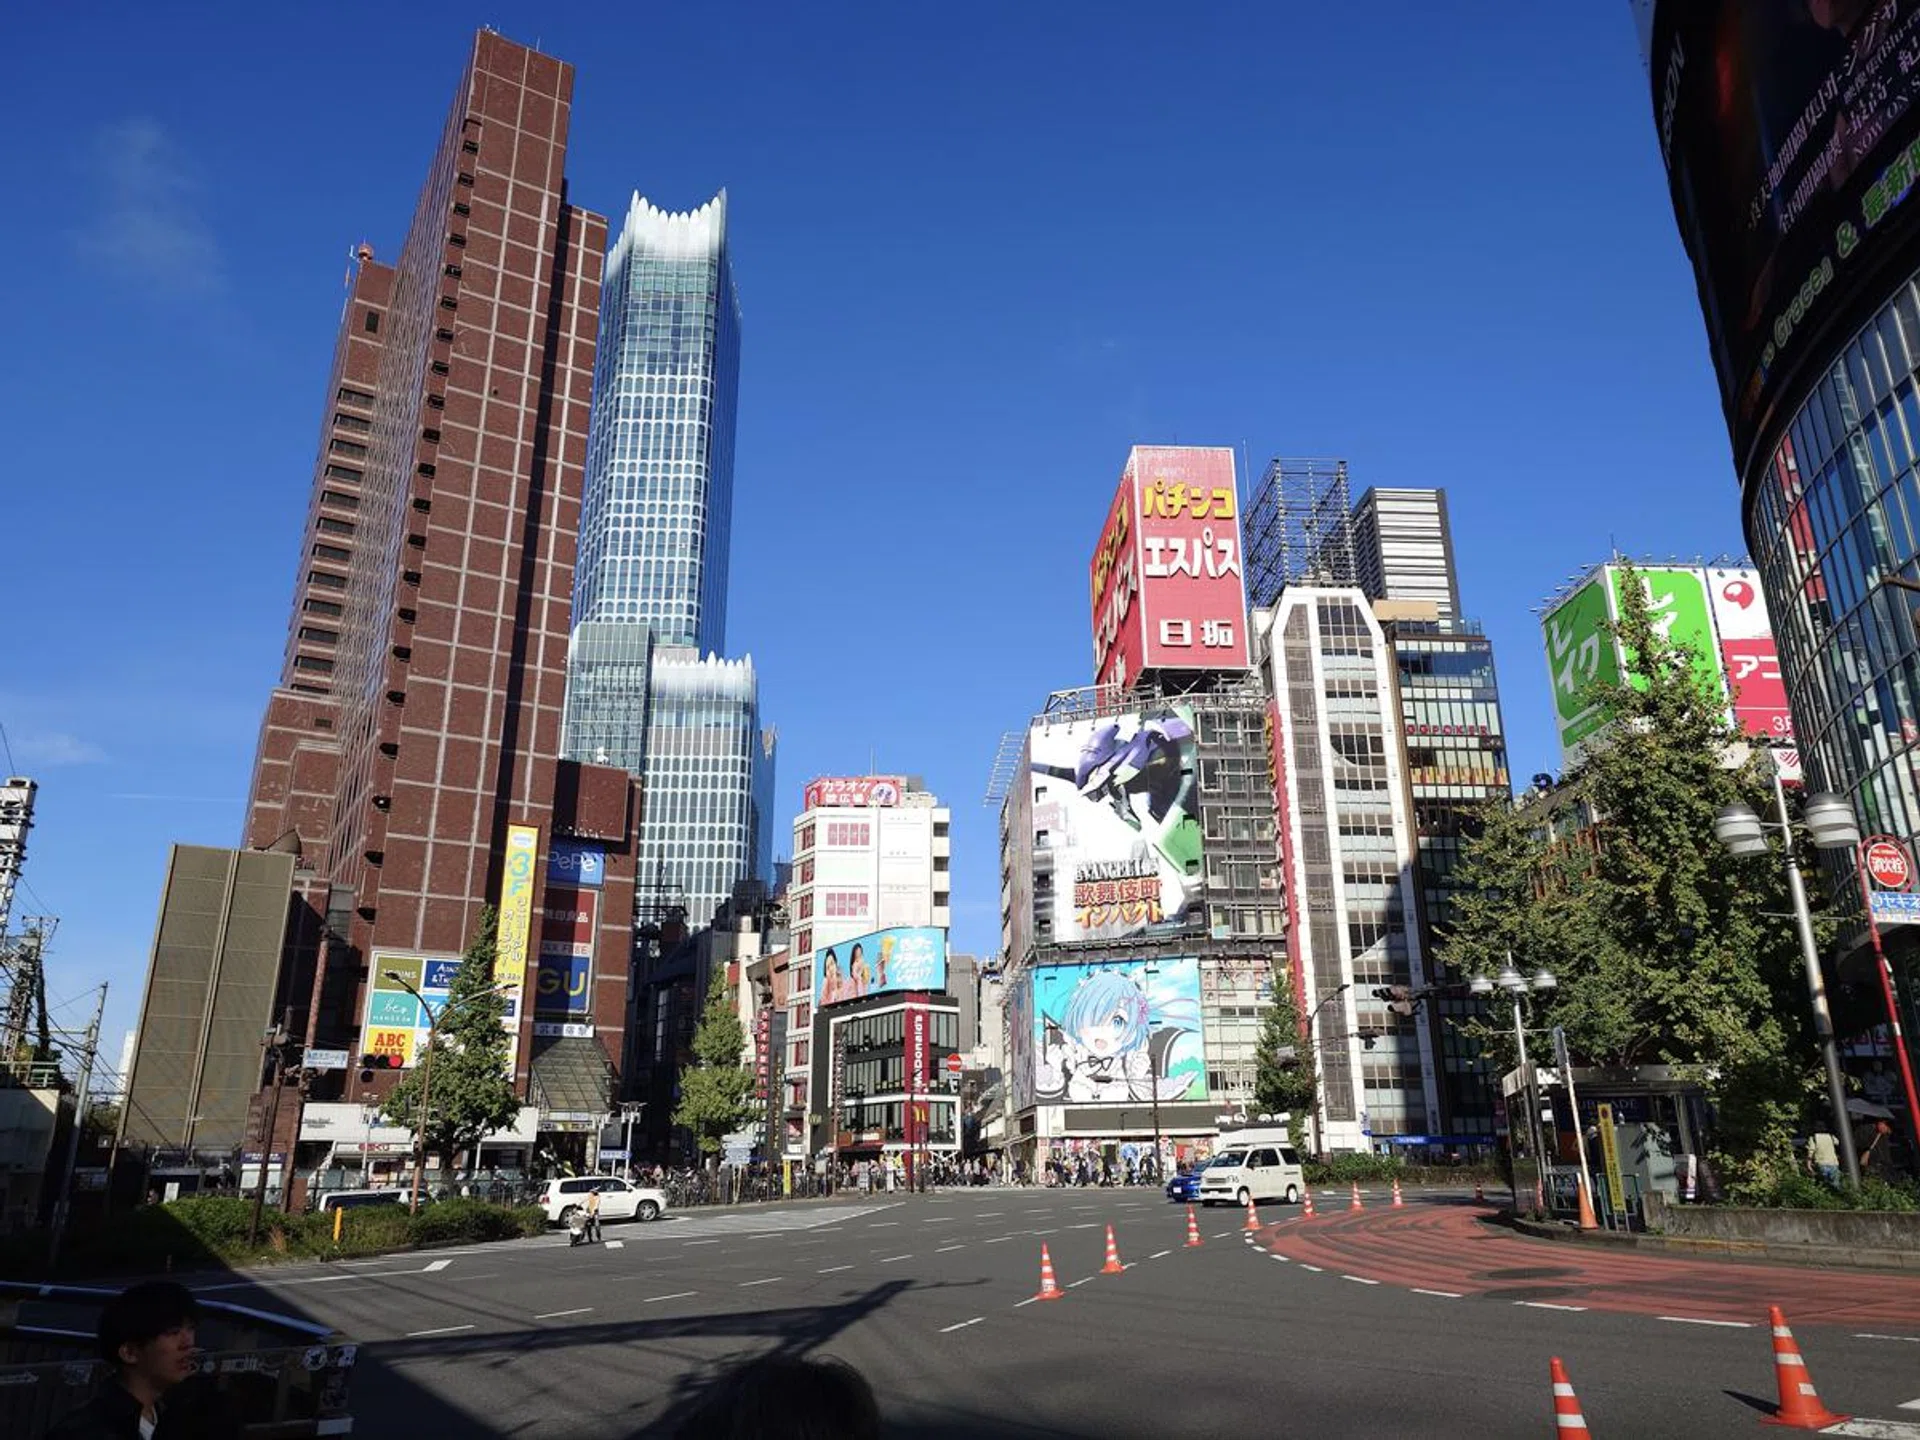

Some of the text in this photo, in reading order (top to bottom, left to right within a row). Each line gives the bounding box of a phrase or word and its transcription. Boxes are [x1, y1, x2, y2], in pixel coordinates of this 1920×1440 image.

[1143, 477, 1235, 519] パチンコ
[1144, 527, 1240, 579] エスパス
[1160, 618, 1234, 648] 日拓
[822, 780, 870, 792] カラオケ
[548, 849, 596, 872] PePe
[1075, 857, 1160, 882] EVANGELION
[1871, 856, 1904, 873] 消火栓
[1075, 879, 1162, 906] 歌舞伎町
[1075, 901, 1165, 929] インパクト
[537, 966, 586, 998] GU
[375, 1032, 406, 1047] ABC
[914, 1014, 924, 1089] McDonald's
